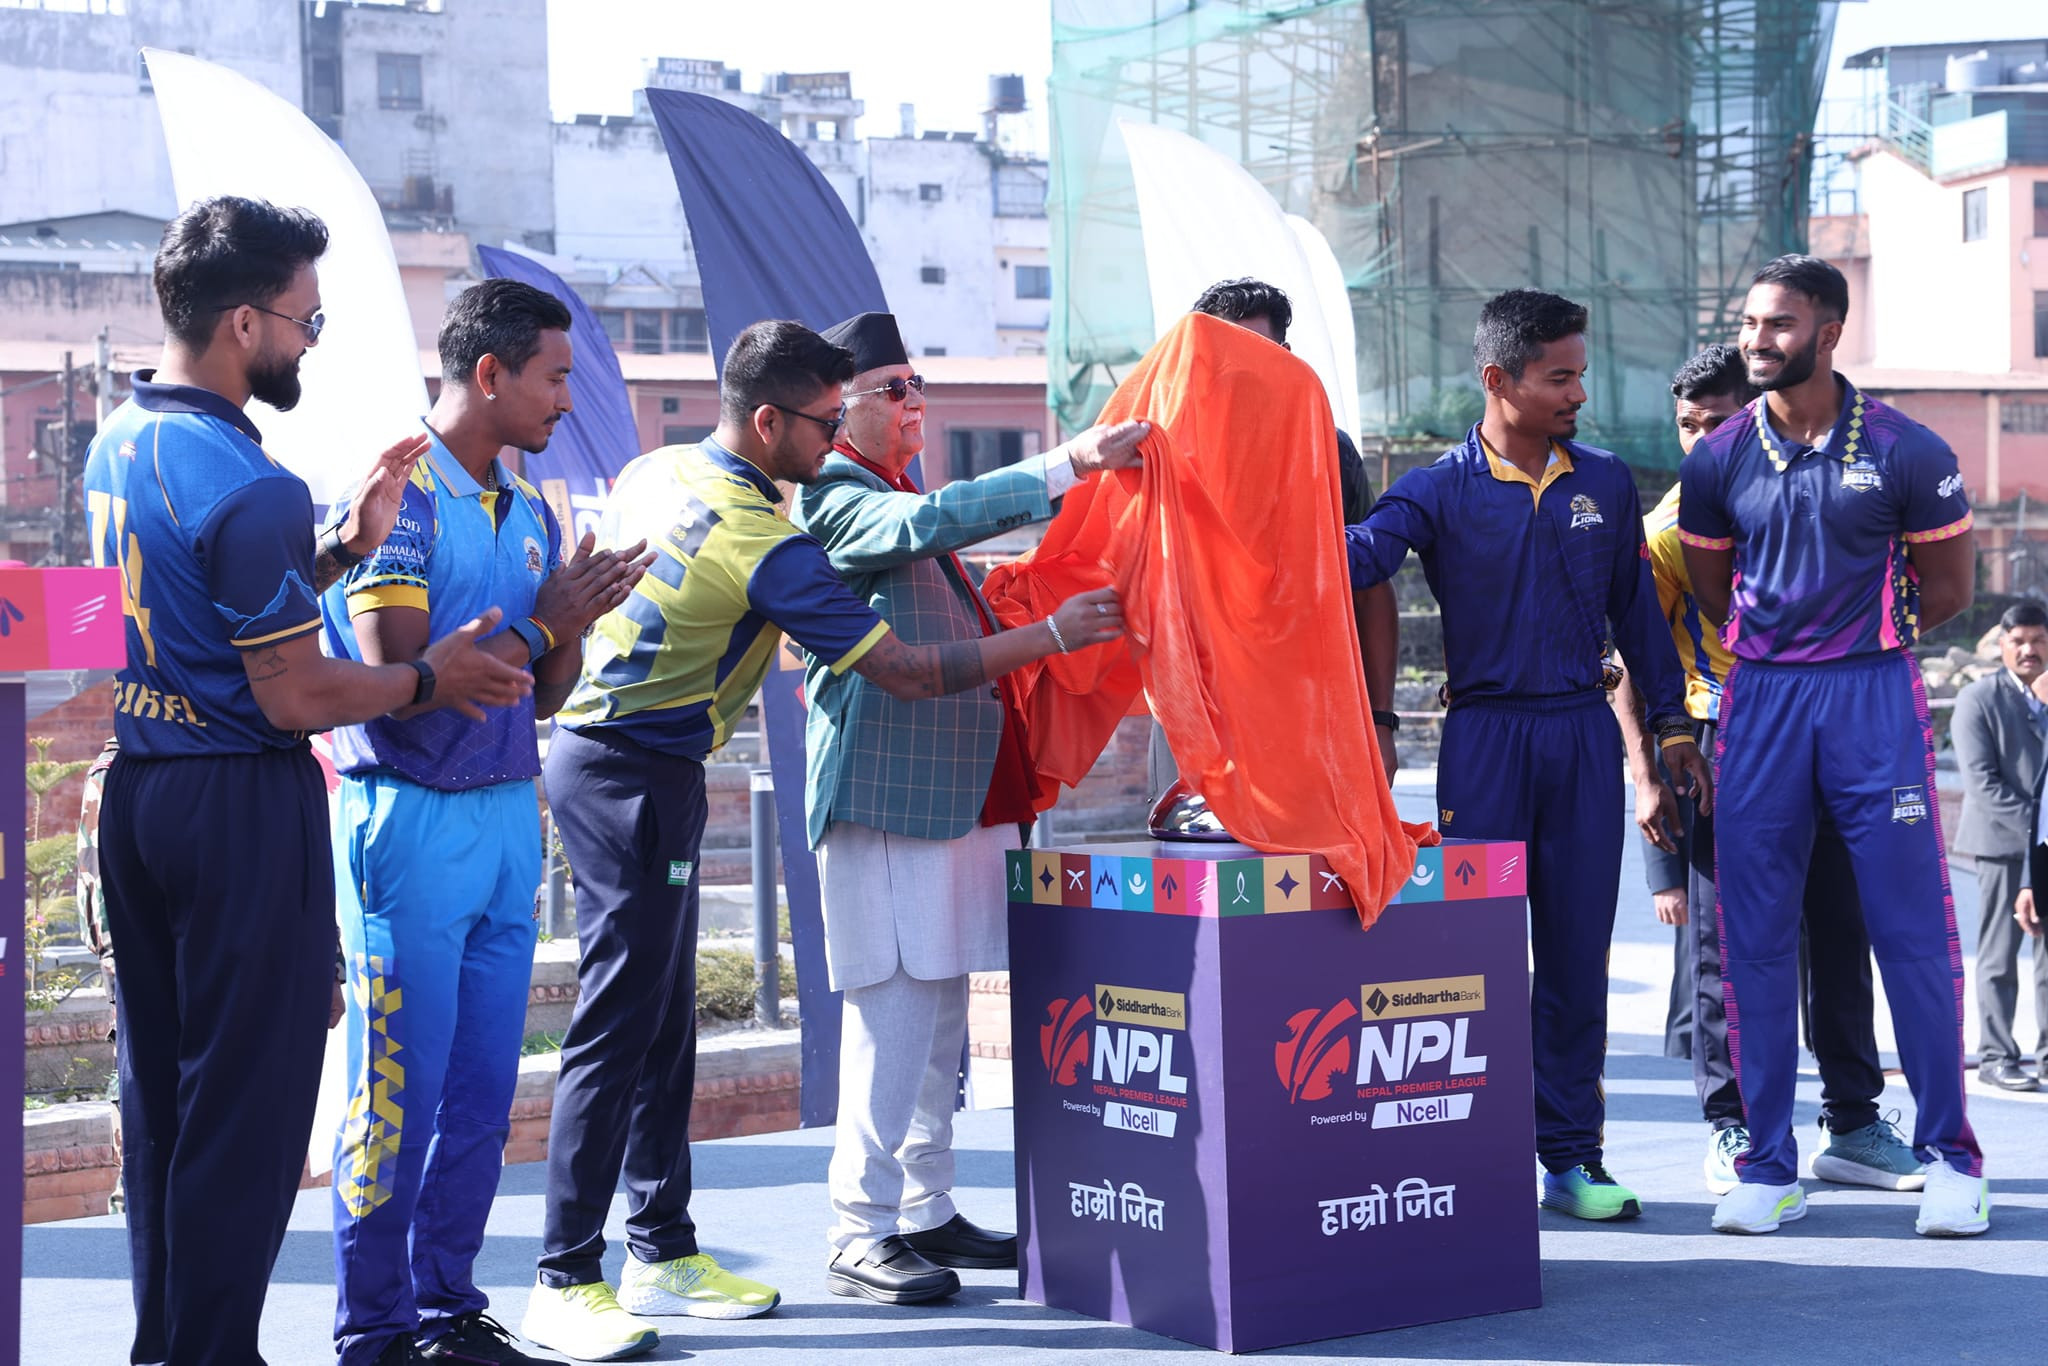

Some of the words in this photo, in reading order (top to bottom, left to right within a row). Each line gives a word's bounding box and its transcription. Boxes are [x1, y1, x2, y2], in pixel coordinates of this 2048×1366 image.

[664, 59, 717, 75] HOTEL
[396, 514, 421, 533] ton
[1892, 804, 1927, 819] BOLTS
[1092, 1025, 1188, 1094] NPL
[1356, 1018, 1487, 1085] NPL
[1093, 1085, 1118, 1097] NEPAL
[1120, 1088, 1154, 1102] PREMIER
[1155, 1095, 1188, 1108] LEAGUE
[1357, 1088, 1392, 1099] NEPAL
[1395, 1081, 1442, 1095] PREMIER
[1445, 1076, 1487, 1090] LEAGUE
[1063, 1099, 1090, 1112] Powered
[1092, 1104, 1101, 1116] by
[1121, 1106, 1158, 1132] Ncell
[1311, 1111, 1352, 1125] Powered
[1355, 1110, 1367, 1123] by
[1397, 1098, 1448, 1123] Ncell
[1069, 1178, 1116, 1221] हाम्रो
[1119, 1182, 1165, 1231] जित
[1318, 1184, 1389, 1236] हाम्रो
[1393, 1177, 1456, 1222] जित
